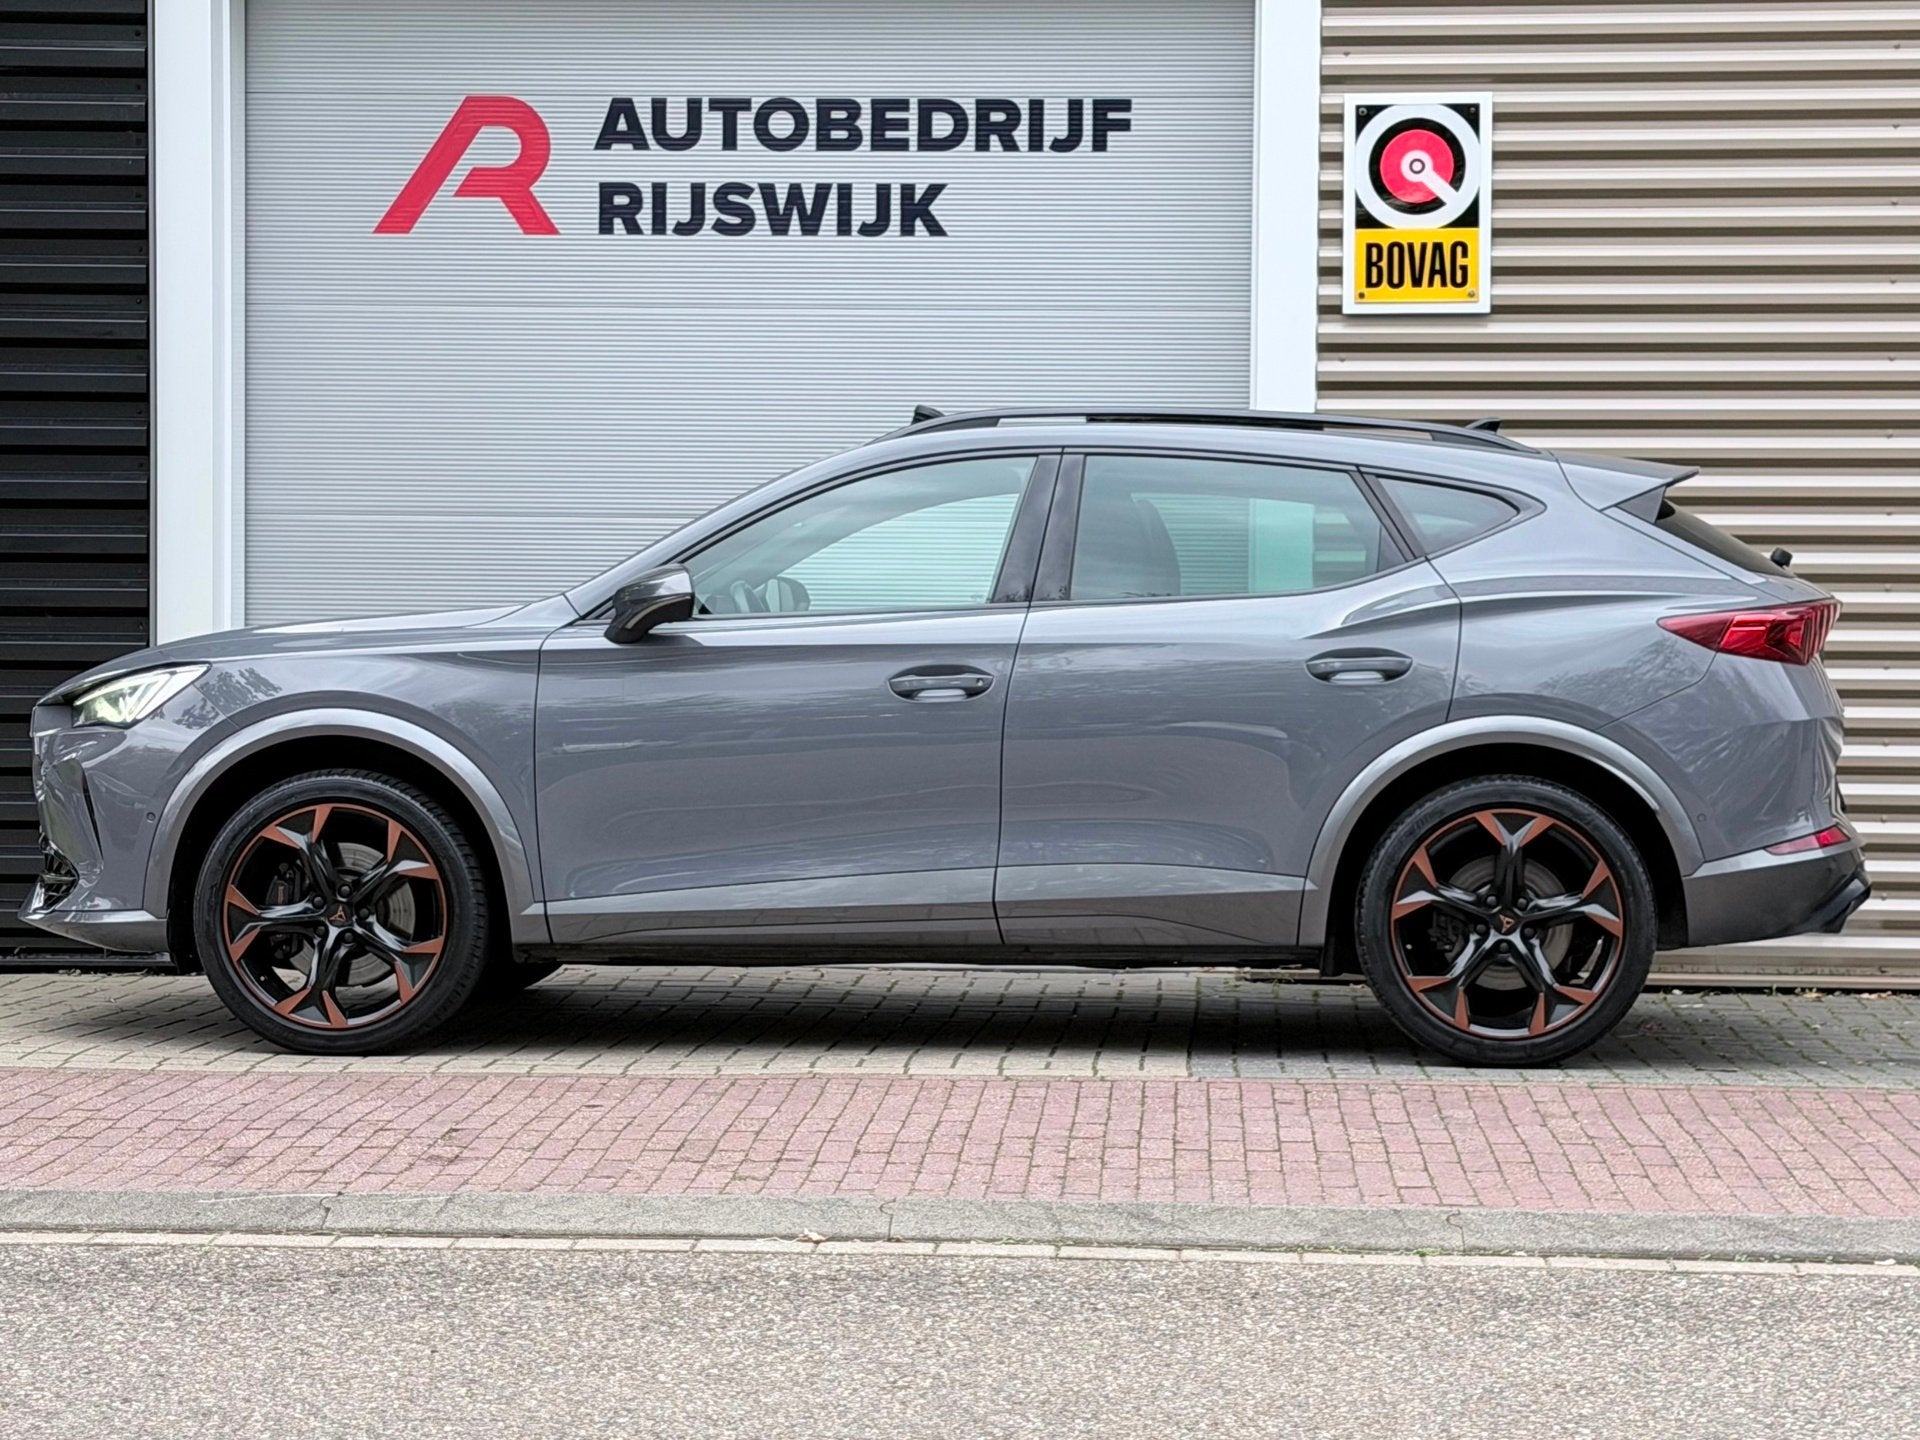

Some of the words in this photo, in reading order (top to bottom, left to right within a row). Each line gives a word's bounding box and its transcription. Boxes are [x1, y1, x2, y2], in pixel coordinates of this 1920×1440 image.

[594, 97, 1132, 153] AUTOBEDRIJF
[598, 181, 948, 237] RIJSWIJK
[1365, 240, 1469, 290] BOVAG
